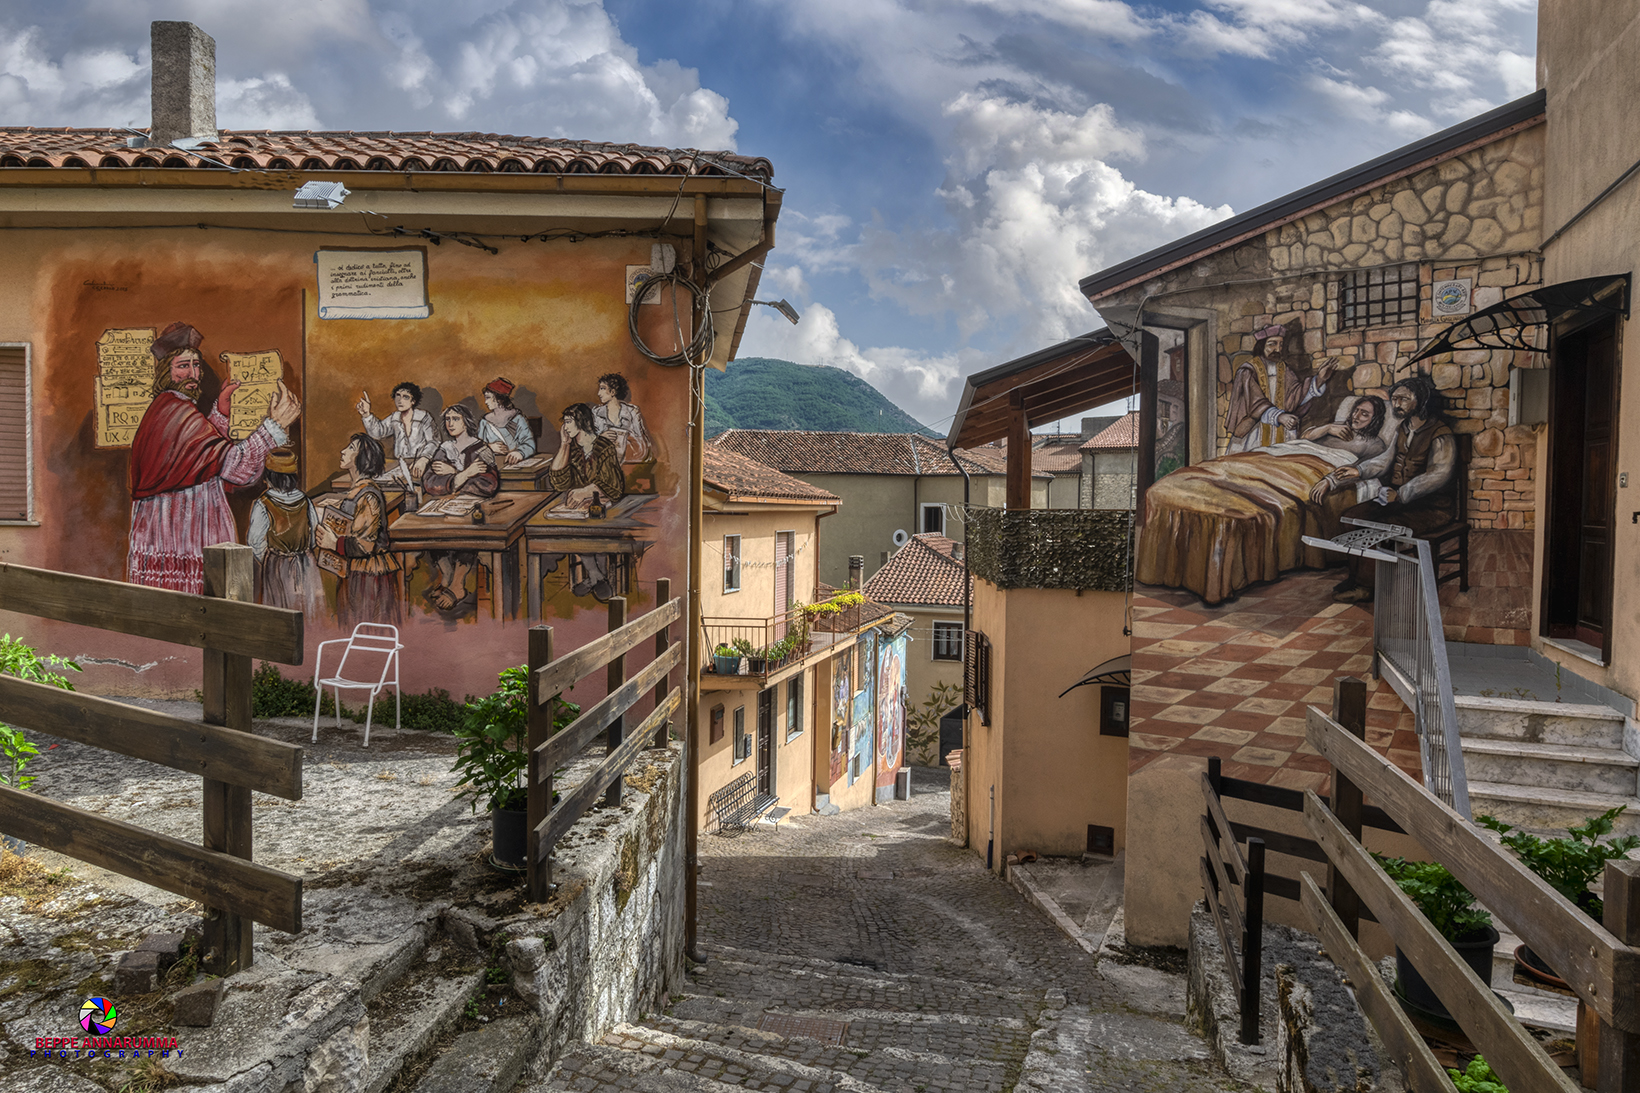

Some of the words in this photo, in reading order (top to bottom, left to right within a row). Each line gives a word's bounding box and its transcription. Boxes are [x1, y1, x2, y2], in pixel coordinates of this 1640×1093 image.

[330, 270, 357, 278] insegnare
[330, 276, 343, 284] alla
[400, 272, 417, 280] anche
[331, 290, 372, 299] grammatica.
